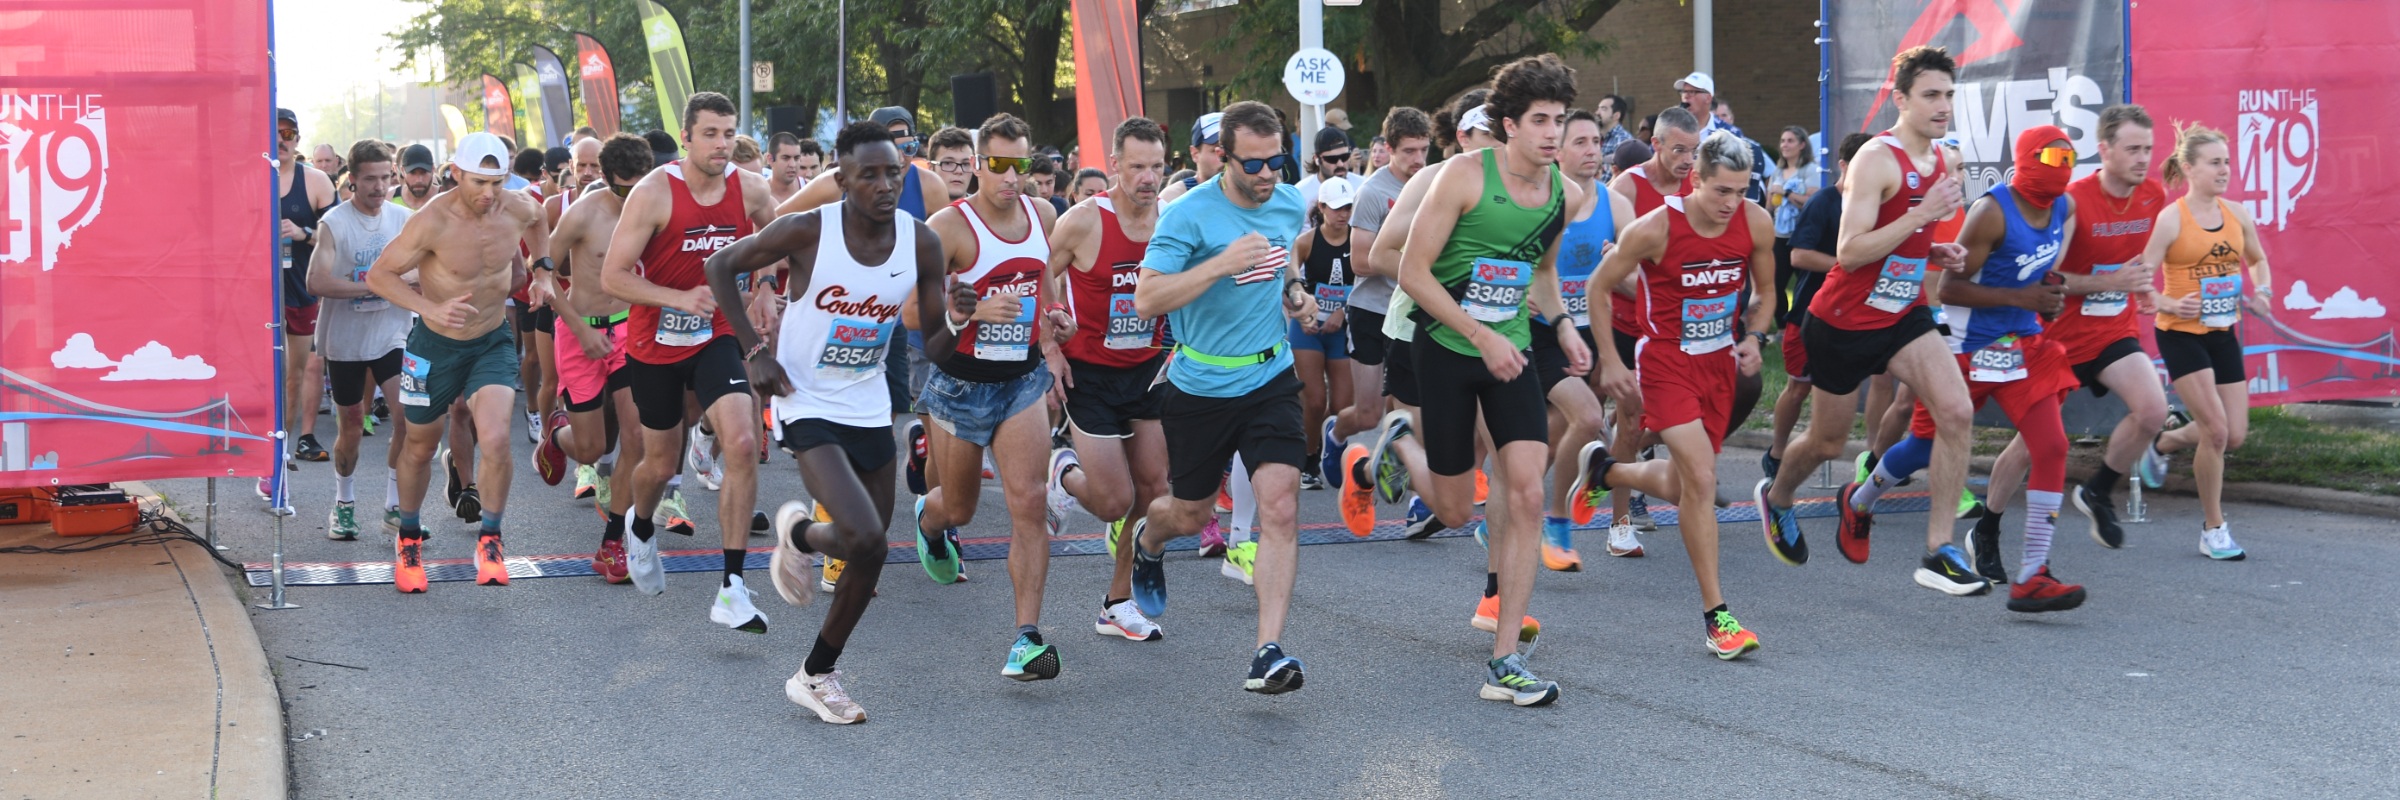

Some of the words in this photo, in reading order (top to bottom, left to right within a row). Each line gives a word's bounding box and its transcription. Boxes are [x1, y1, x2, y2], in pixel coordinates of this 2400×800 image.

[1295, 58, 1331, 70] ASK
[1301, 71, 1327, 84] ME
[1944, 66, 2104, 163] AVE'S
[2243, 112, 2315, 231] 419
[2092, 218, 2151, 237] HUSKIES
[681, 235, 737, 252] DAVE'S
[1477, 263, 1519, 281] RIVER
[1681, 267, 1742, 287] DAVE'S
[1465, 283, 1517, 305] 3348
[1874, 278, 1912, 299] 3453
[815, 284, 903, 324] Cowboy
[1687, 302, 1726, 319] RIVER
[663, 313, 701, 331] 3178
[1110, 317, 1148, 334] 3150
[1685, 319, 1725, 338] 3318
[833, 325, 880, 343] RIVER
[977, 323, 1024, 342] 3568
[822, 346, 875, 365] 3354
[1972, 349, 2013, 368] 4523
